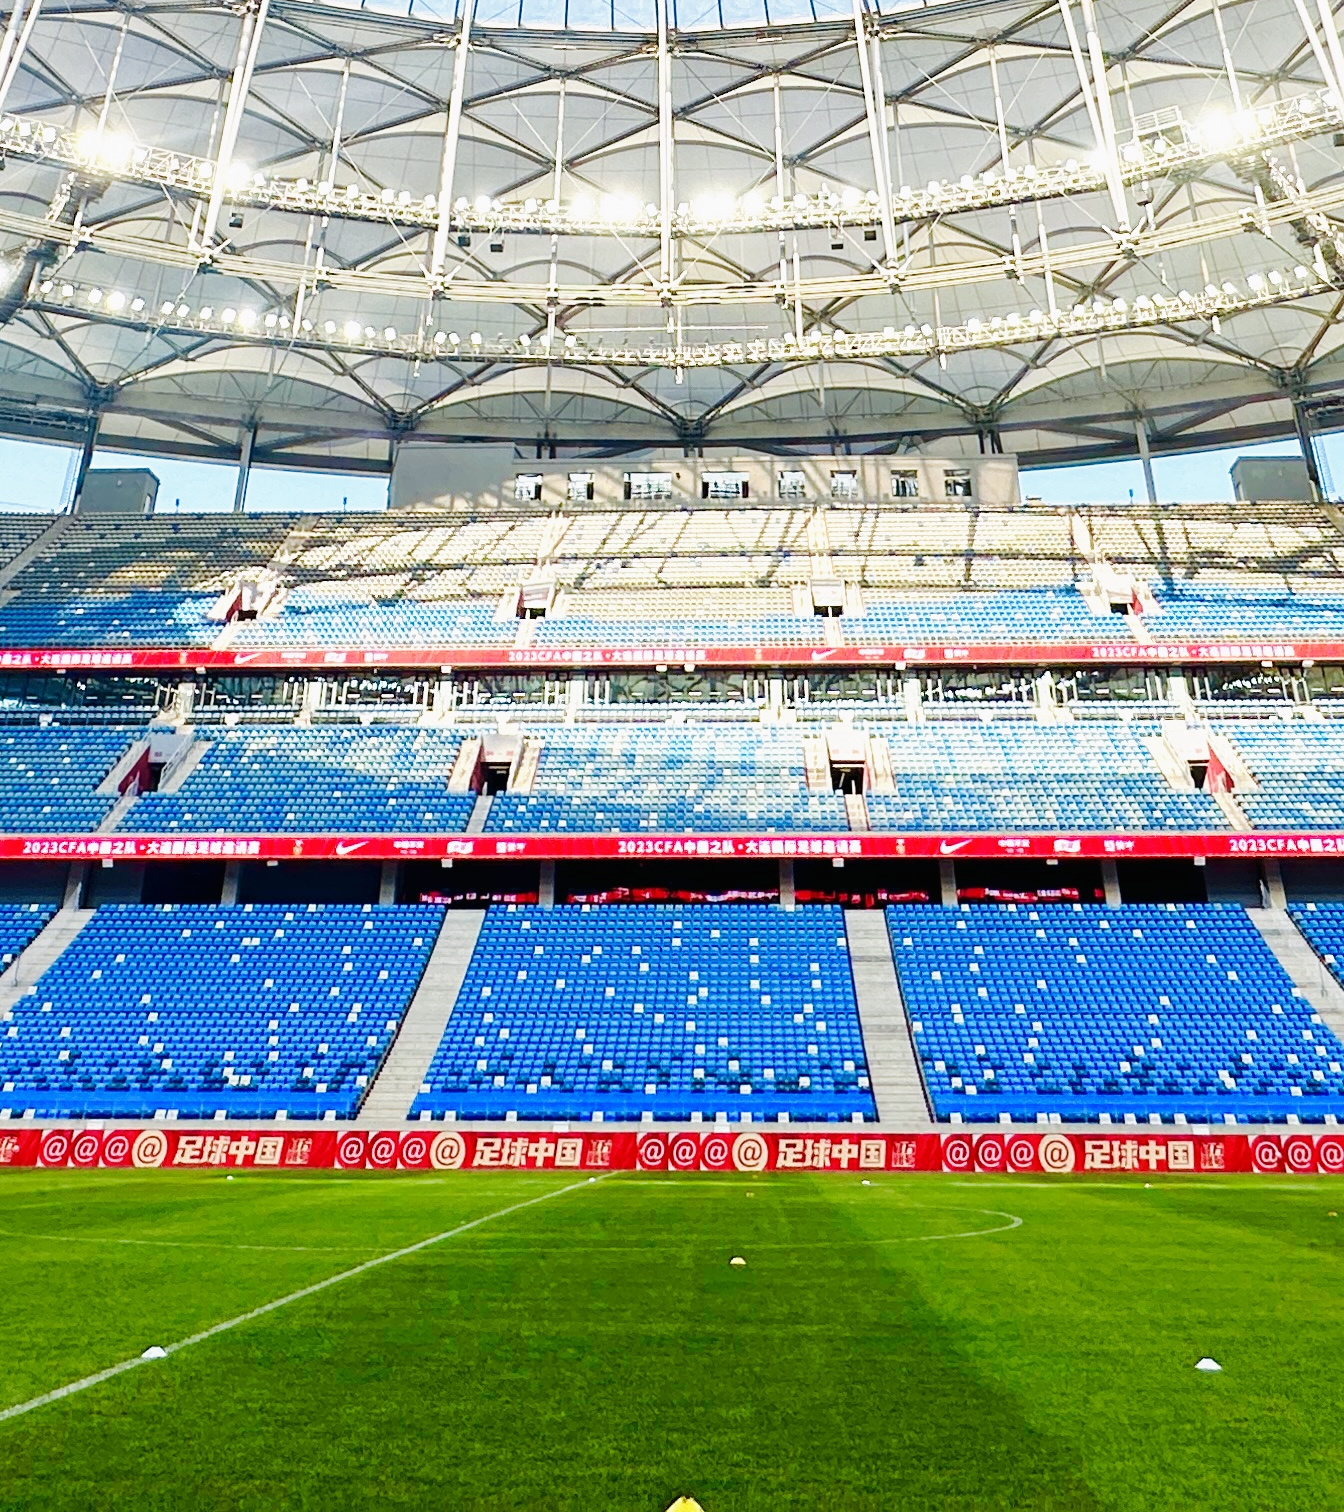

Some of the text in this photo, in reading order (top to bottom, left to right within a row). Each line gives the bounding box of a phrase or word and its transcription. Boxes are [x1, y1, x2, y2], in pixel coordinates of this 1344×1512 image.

[43, 1135, 68, 1163] @
[74, 1135, 99, 1163] @
[104, 1135, 129, 1163] @
[172, 1135, 284, 1165] 足球中国
[340, 1137, 365, 1165] @
[371, 1137, 396, 1165] @
[402, 1137, 427, 1165] @
[471, 1137, 583, 1167] 足球中国
[640, 1138, 665, 1166] @
[672, 1138, 697, 1166] @
[704, 1138, 729, 1166] @
[775, 1138, 887, 1169] 足球中国
[946, 1140, 970, 1168] @
[978, 1140, 1002, 1168] @
[1010, 1140, 1034, 1168] @
[1084, 1139, 1195, 1170] 足球中国
[1256, 1141, 1282, 1169] @
[1287, 1141, 1313, 1169] @
